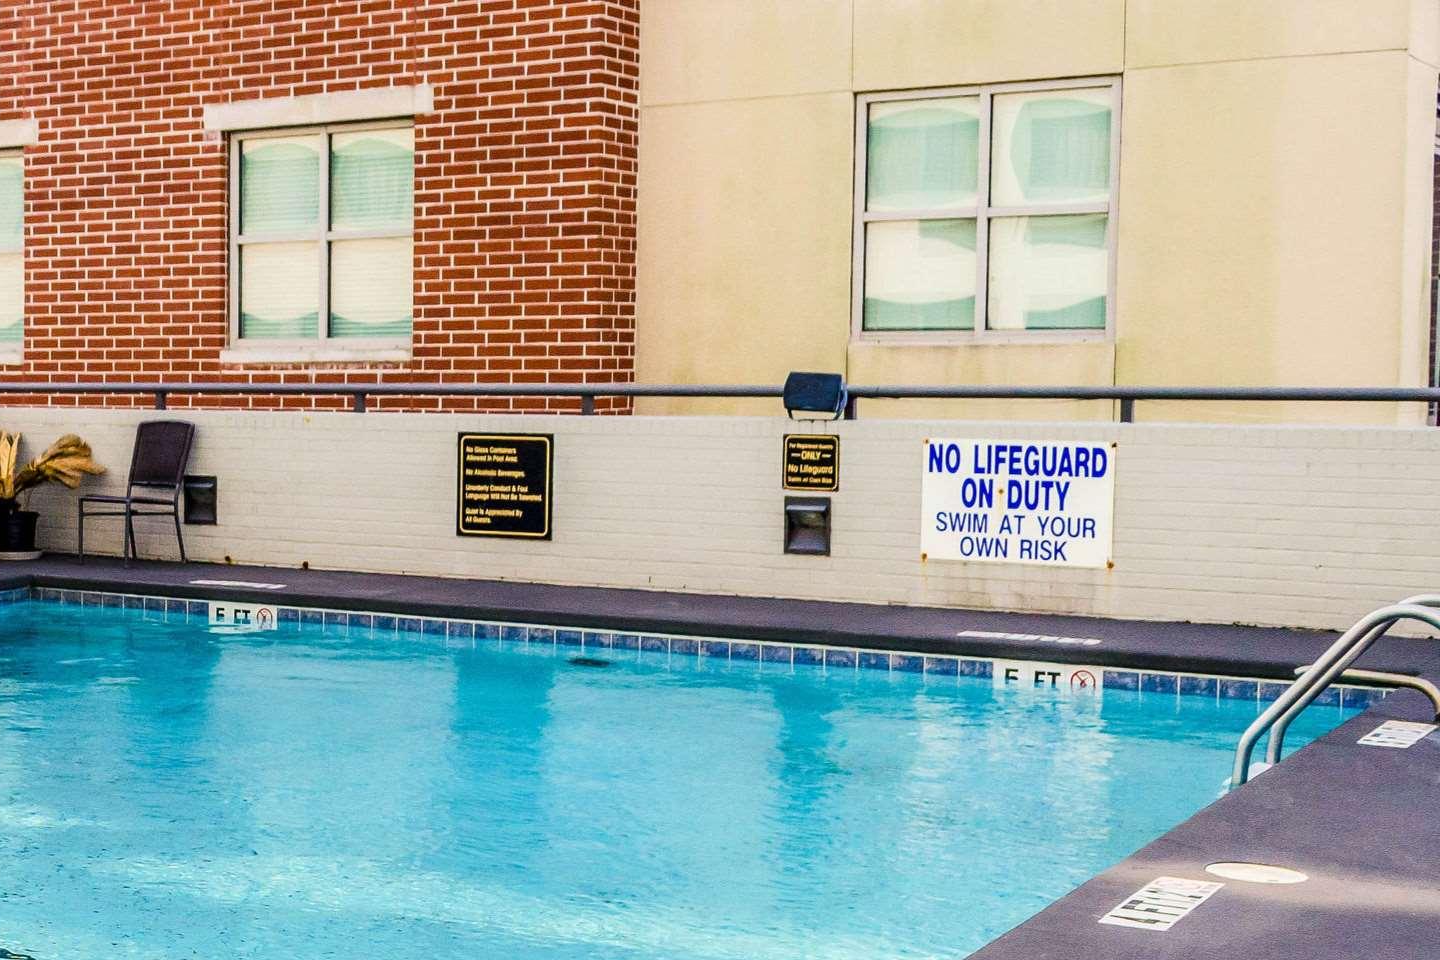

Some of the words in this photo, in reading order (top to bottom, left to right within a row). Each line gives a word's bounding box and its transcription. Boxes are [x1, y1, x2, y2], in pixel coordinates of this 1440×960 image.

[801, 451, 821, 460] ONLY
[928, 443, 961, 473] NO
[973, 444, 1107, 478] LIFEGUARD
[788, 464, 799, 473] No
[800, 464, 833, 475] Lifeguard
[961, 478, 994, 508] ON
[1007, 479, 1070, 511] DUTY
[936, 512, 988, 533] SWIM
[999, 514, 1026, 535] AT
[1037, 516, 1096, 539] YOUR
[960, 536, 1009, 558] OWN
[1019, 539, 1068, 561] RISK
